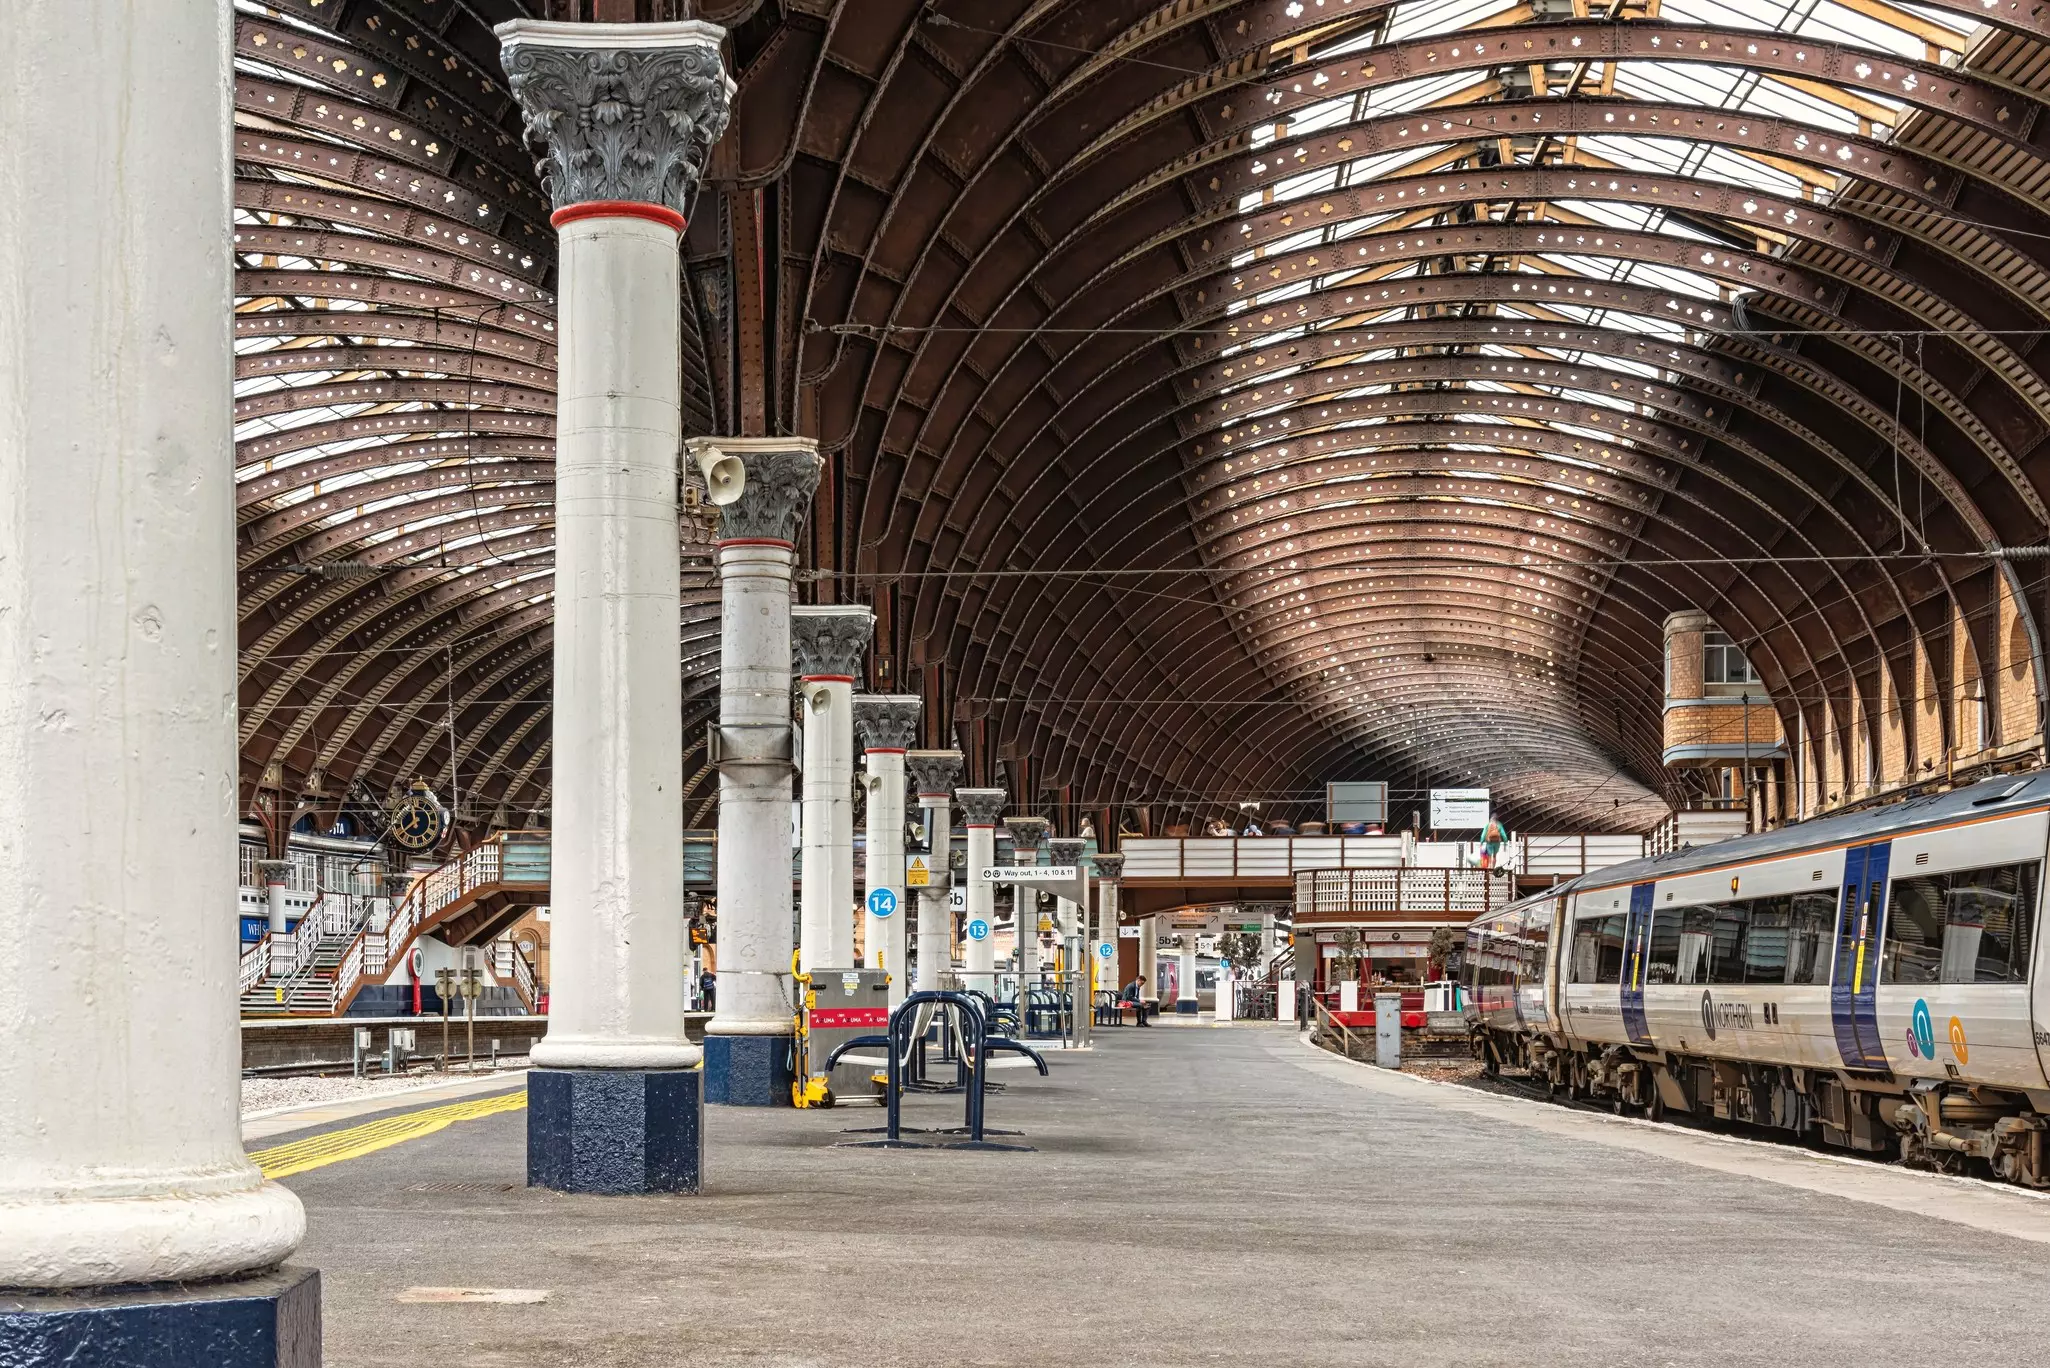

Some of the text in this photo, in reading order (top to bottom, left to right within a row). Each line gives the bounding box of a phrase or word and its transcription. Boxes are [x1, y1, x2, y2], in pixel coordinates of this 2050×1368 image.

[871, 896, 893, 912] 14
[972, 925, 985, 937] 13
[1158, 936, 1171, 945] 5b
[1101, 947, 1112, 956] 12
[1713, 1003, 1754, 1030] NORTHERN
